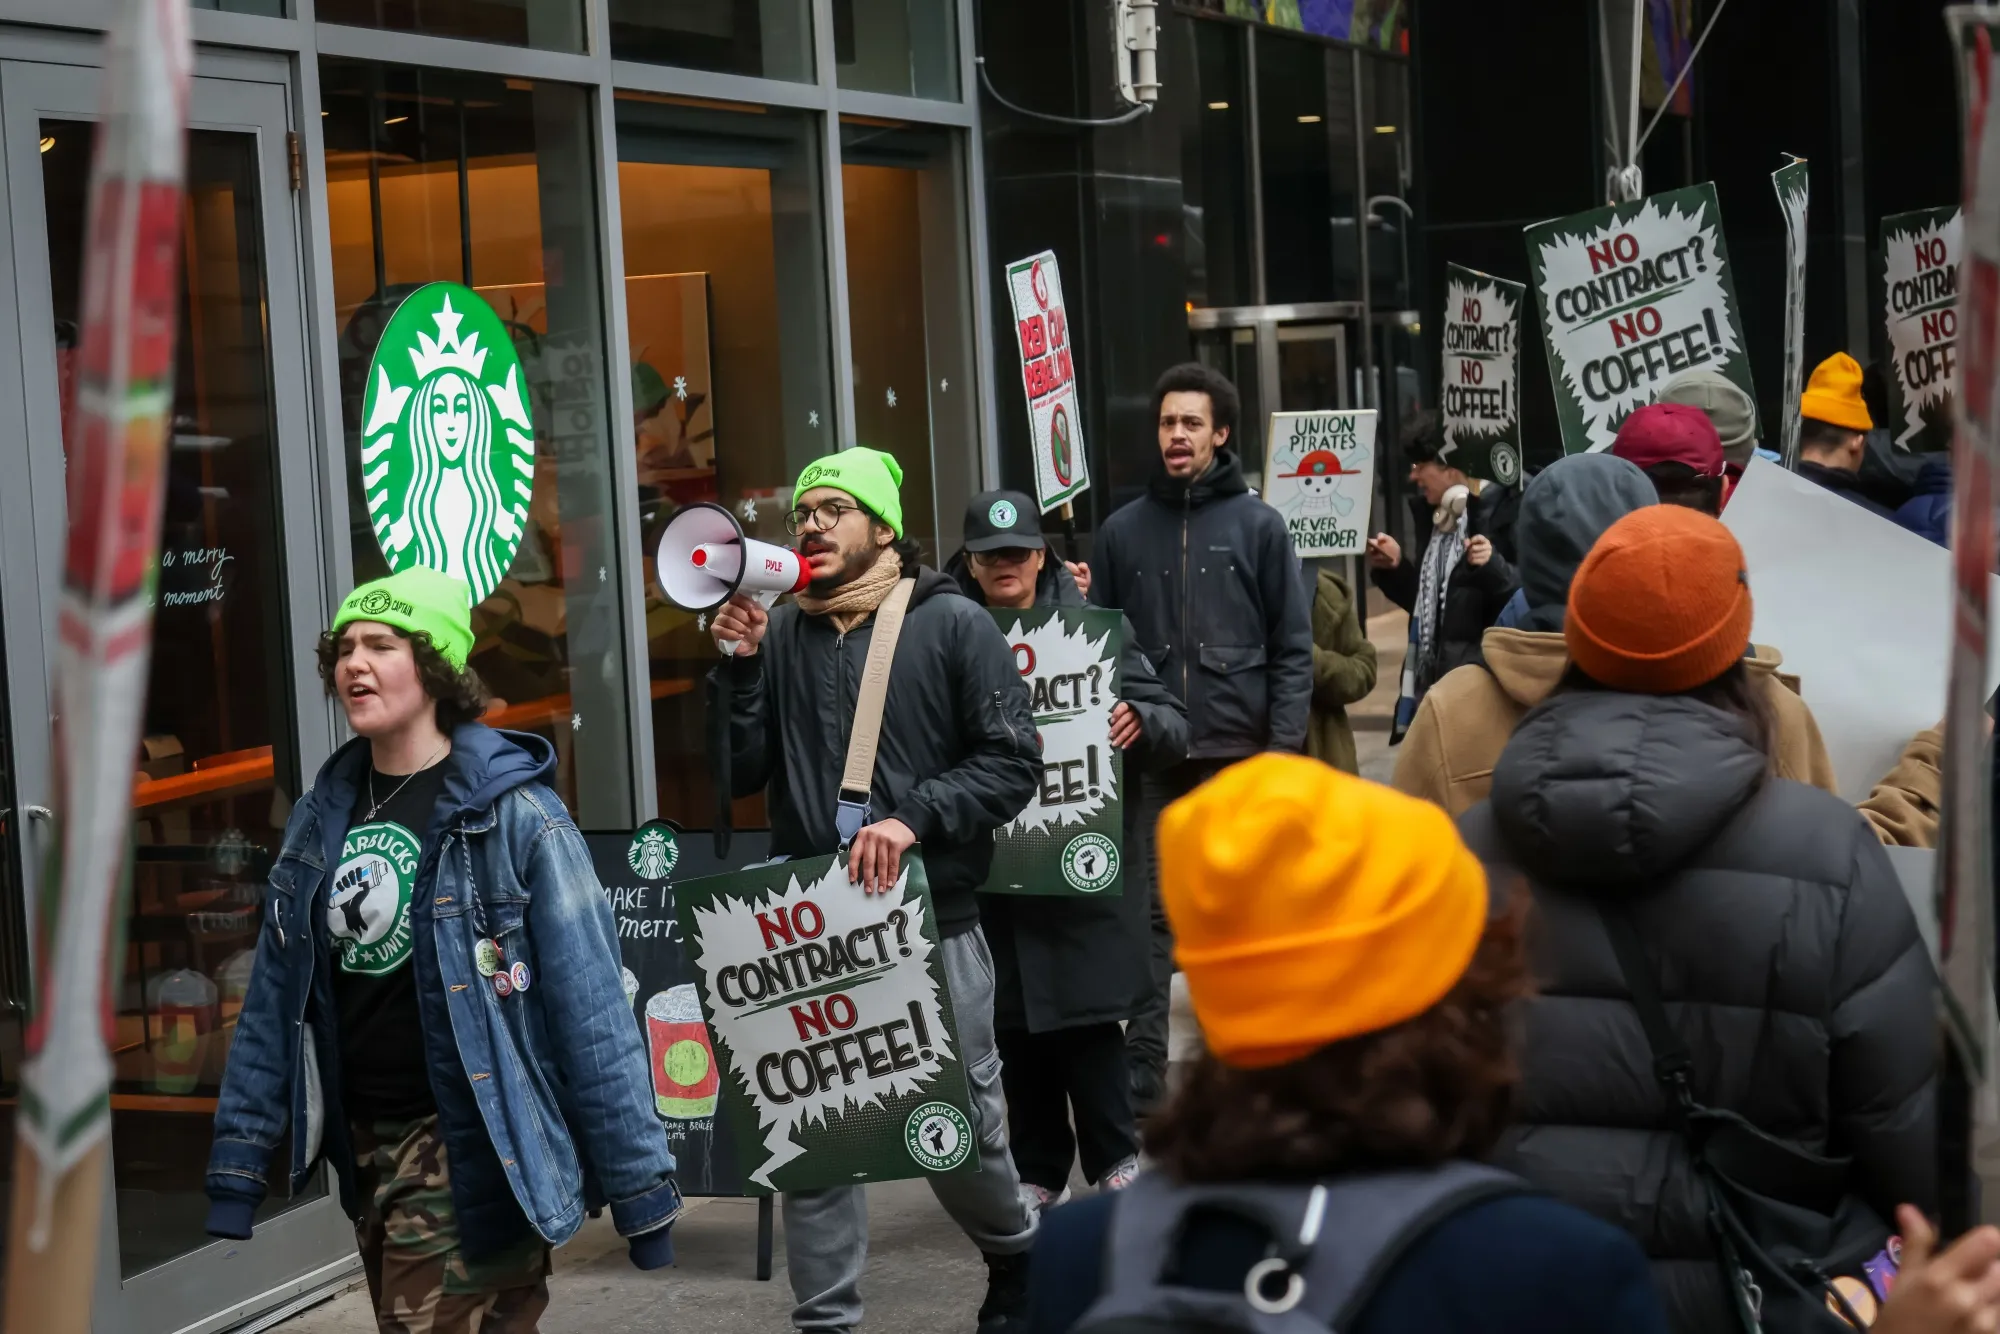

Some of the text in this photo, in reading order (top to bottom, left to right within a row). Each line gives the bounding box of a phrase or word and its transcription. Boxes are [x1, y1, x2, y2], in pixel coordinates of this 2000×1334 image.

[1586, 233, 1640, 274] NO
[1915, 238, 1947, 272] NO
[1555, 235, 1708, 323] CONTRACT?
[1891, 264, 1960, 313] CONTRA
[1462, 297, 1482, 323] NO
[1608, 306, 1663, 348] NO
[1921, 309, 1958, 344] NO
[1019, 309, 1066, 361] RED CUP
[1447, 322, 1510, 352] CONTRACT?
[1581, 307, 1724, 402] COFFEE!
[1904, 340, 1957, 390] COFF
[1024, 347, 1074, 400] REBELLION
[1461, 359, 1484, 385] NO
[1446, 380, 1507, 419] COFFEE!
[1290, 433, 1356, 452] PIRATES
[1295, 415, 1356, 436] UNION
[1289, 517, 1337, 531] NEVER
[1290, 529, 1358, 549] RRENDER
[162, 548, 234, 580] a merry
[765, 559, 783, 572] PYLE
[164, 576, 224, 607] moment
[391, 600, 414, 617] CAPTAIN
[1011, 642, 1036, 676] O
[342, 832, 418, 875] ARBUCKS
[1070, 836, 1113, 852] STARBUCKS
[1065, 860, 1116, 888] WORKERS UNITED
[618, 916, 684, 943] merr
[754, 900, 825, 951] NO
[715, 909, 913, 1008] CONTRACT?
[788, 993, 858, 1041] NO
[755, 1000, 936, 1105] COFFEE!
[911, 1106, 960, 1127] STARBUCKS
[909, 1132, 968, 1166] WORKERS UNITED
